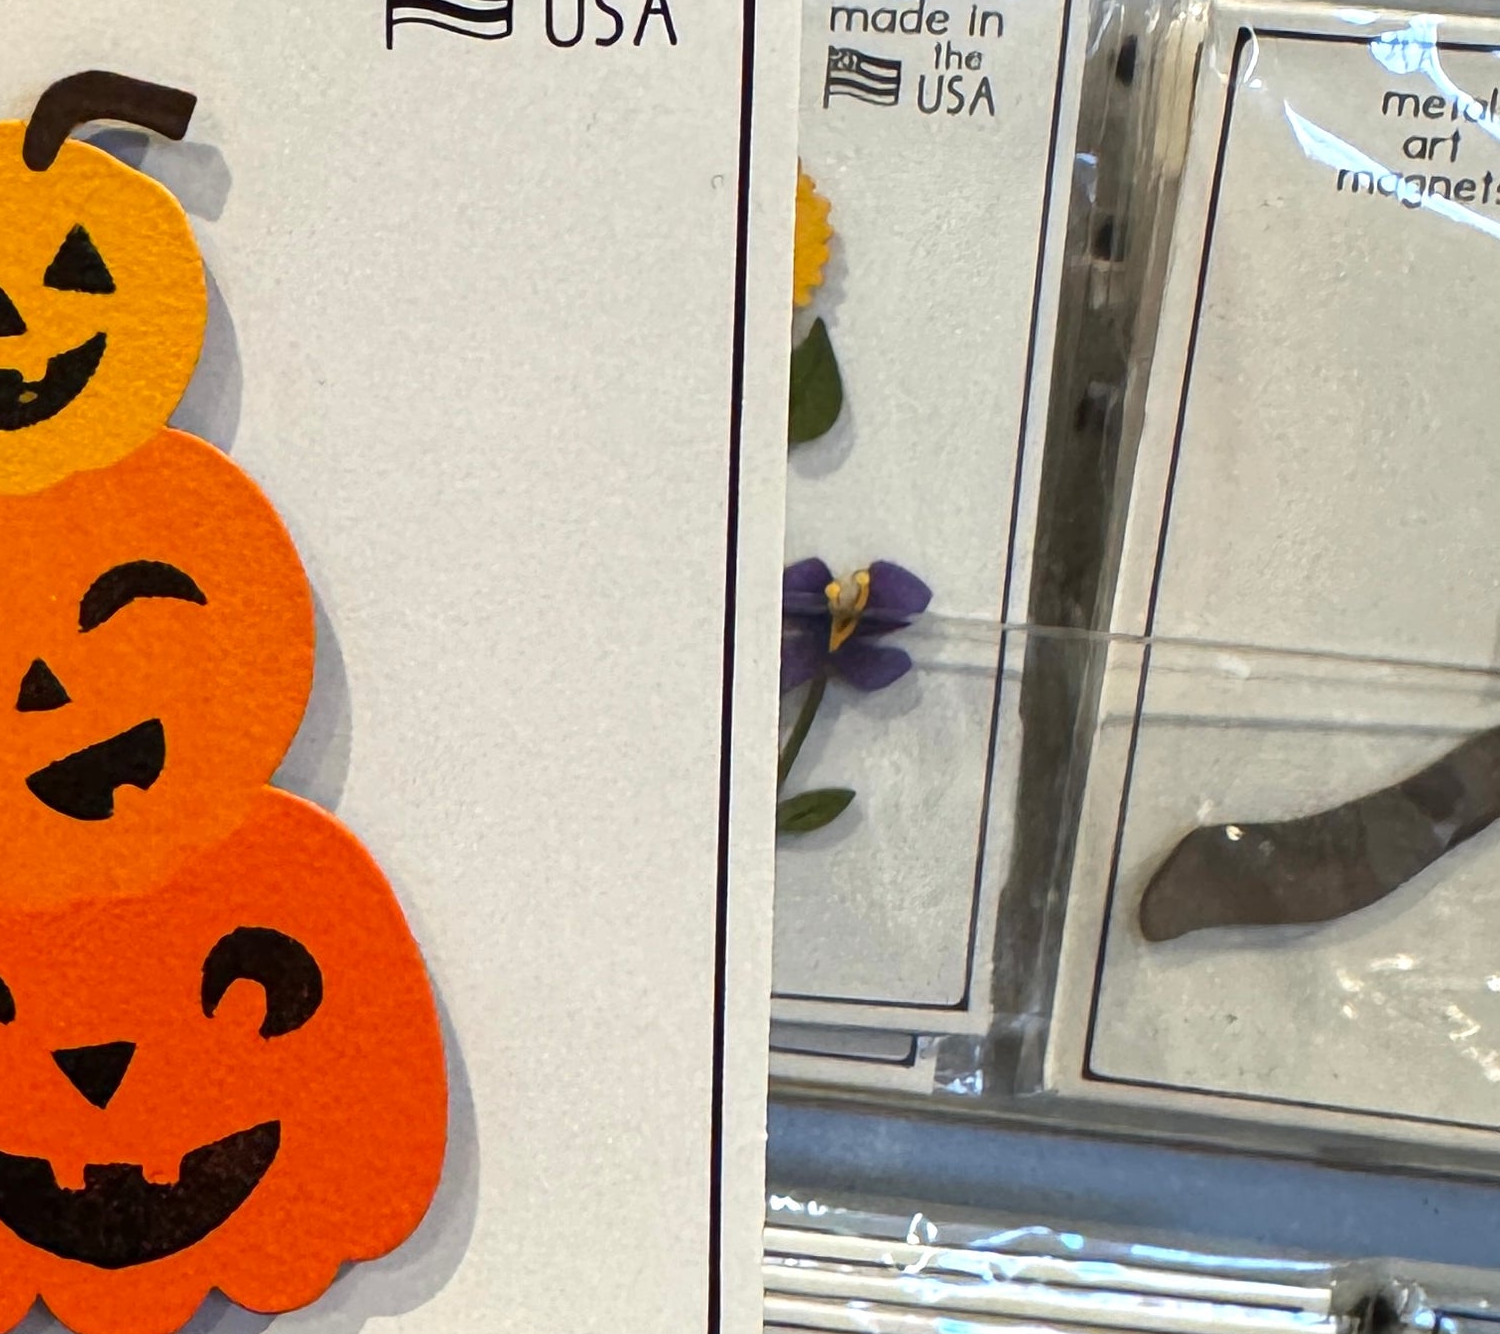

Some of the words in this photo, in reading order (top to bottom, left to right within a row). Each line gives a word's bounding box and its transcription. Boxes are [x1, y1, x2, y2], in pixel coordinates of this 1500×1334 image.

[969, 4, 1004, 38] in
[934, 40, 982, 71] the
[917, 75, 995, 116] USA
[1382, 87, 1498, 123] metal
[1403, 129, 1461, 163] art
